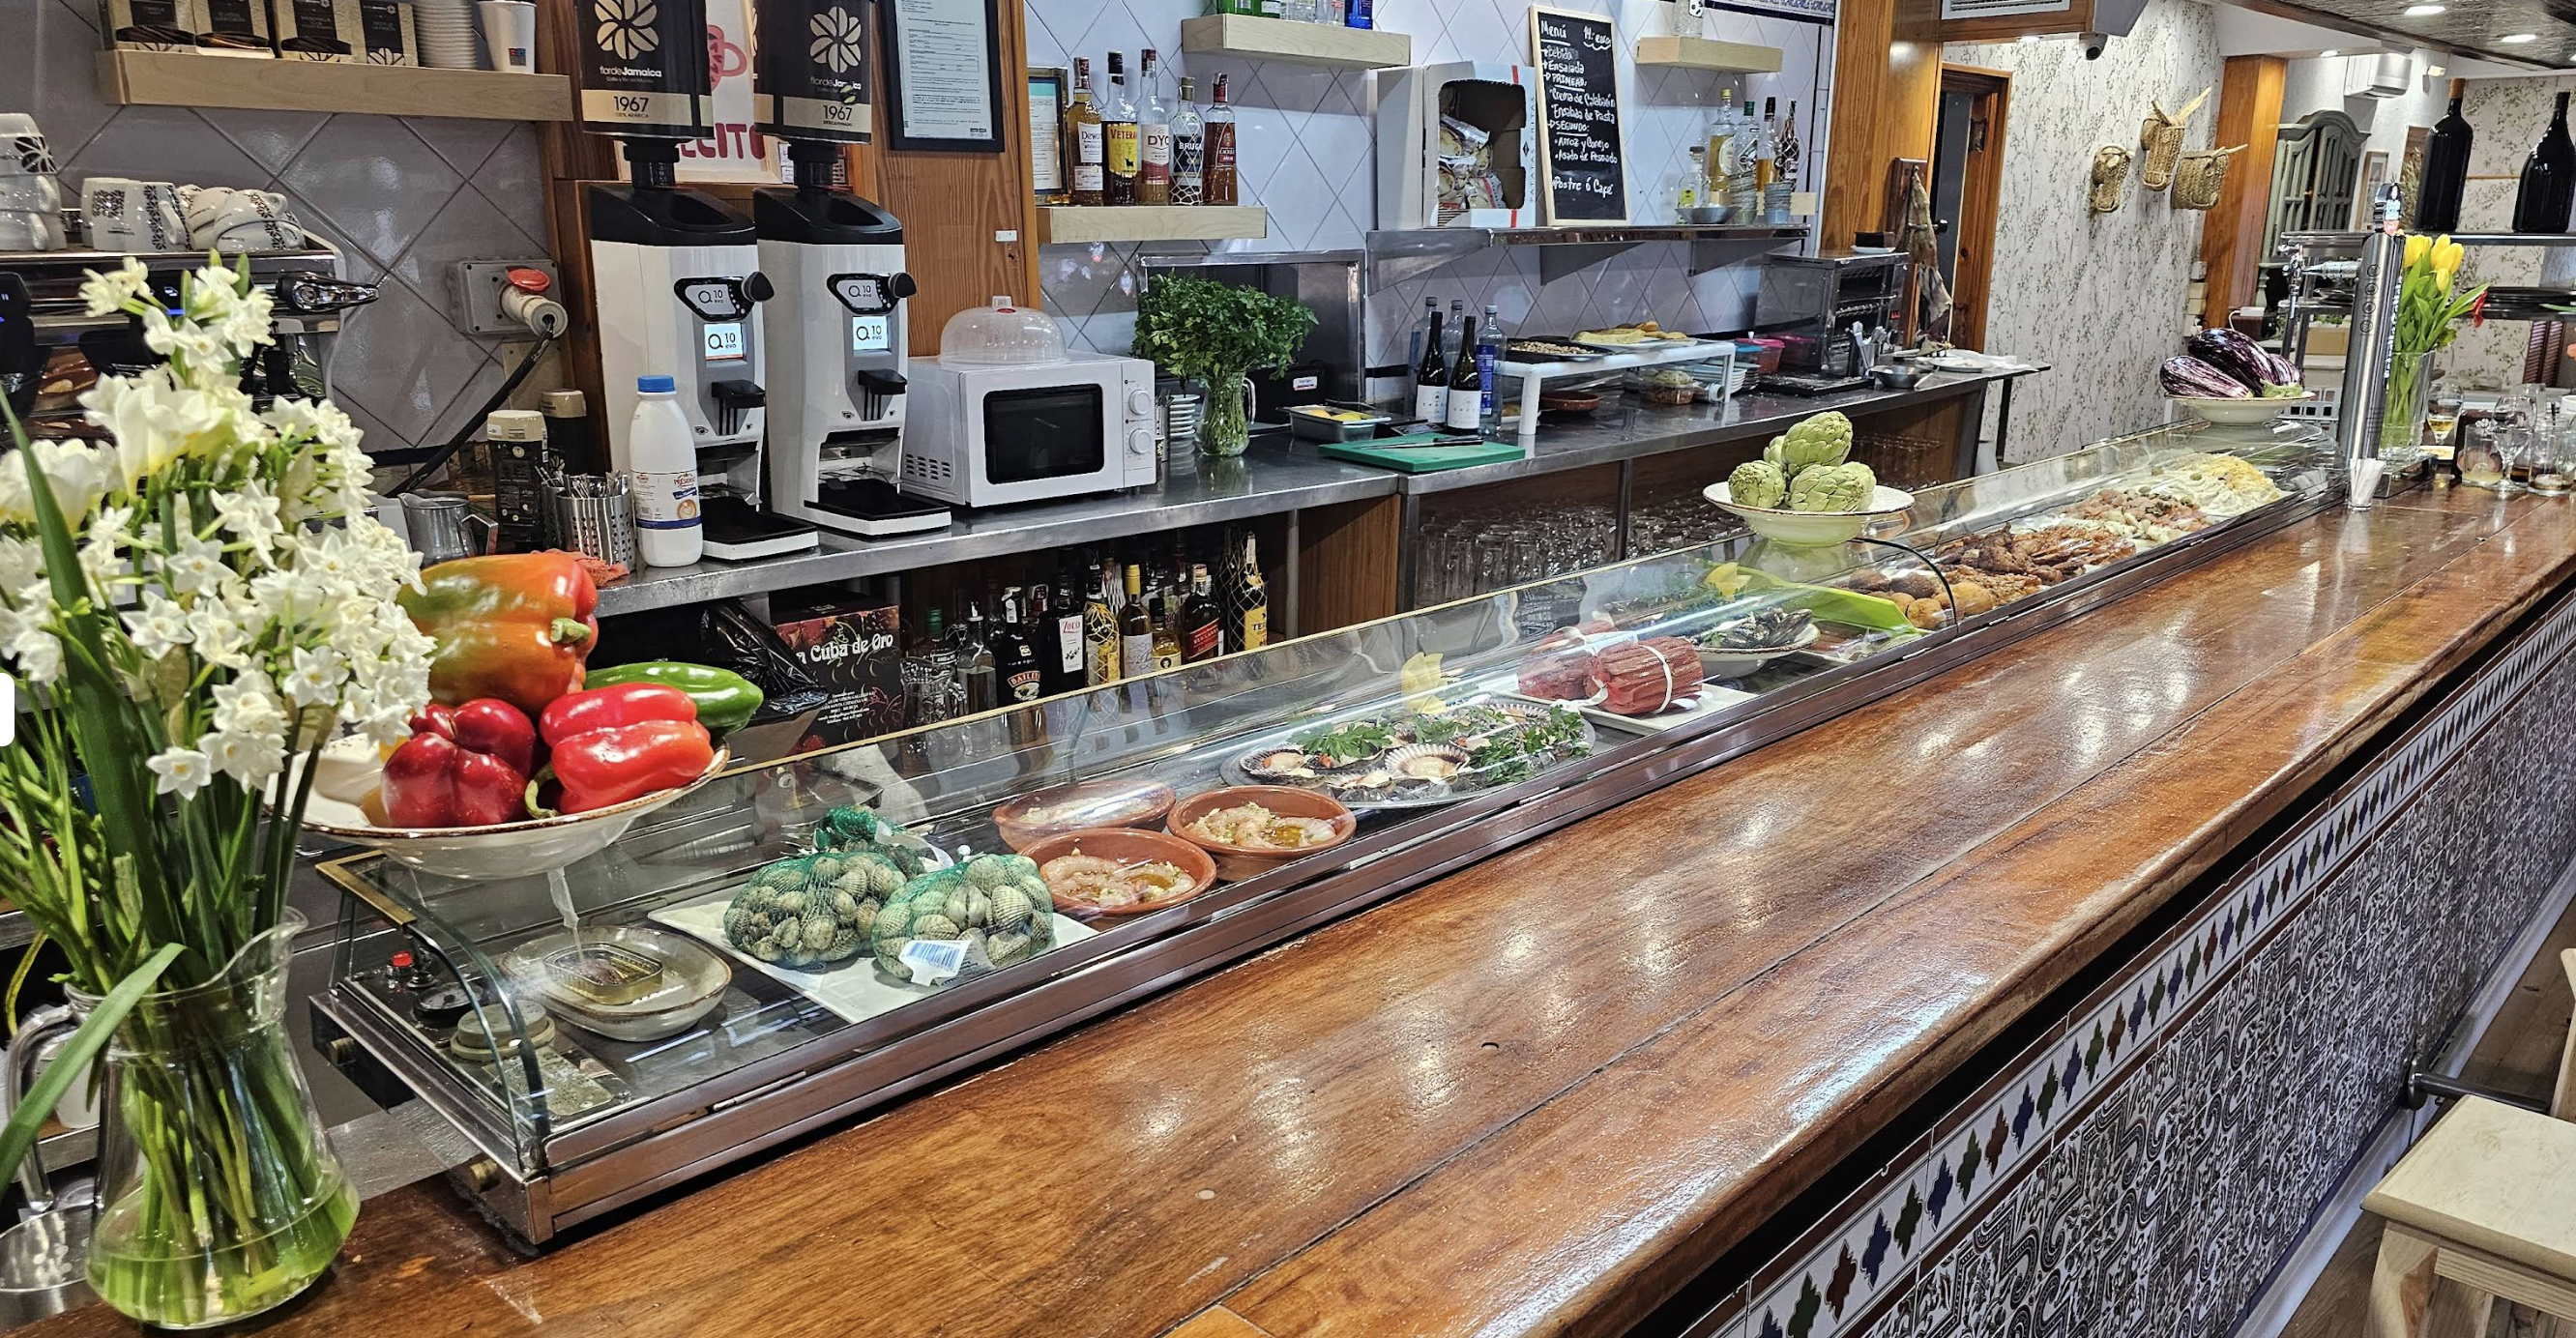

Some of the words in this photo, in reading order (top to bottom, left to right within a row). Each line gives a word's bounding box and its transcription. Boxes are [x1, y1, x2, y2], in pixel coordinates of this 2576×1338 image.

[1540, 20, 1566, 38] Menú
[1548, 60, 1584, 74] Ensalada
[613, 96, 649, 112] 1967
[1574, 94, 1583, 104] de
[823, 104, 853, 121] 1967
[1585, 109, 1594, 121] de
[1581, 140, 1587, 153] y
[1554, 176, 1582, 190] Postre
[713, 290, 723, 299] 10
[862, 284, 871, 293] 10
[871, 325, 882, 335] 10
[724, 333, 736, 343] 10
[810, 644, 848, 662] Cuba
[852, 637, 869, 654] de
[871, 633, 893, 651] Oro
